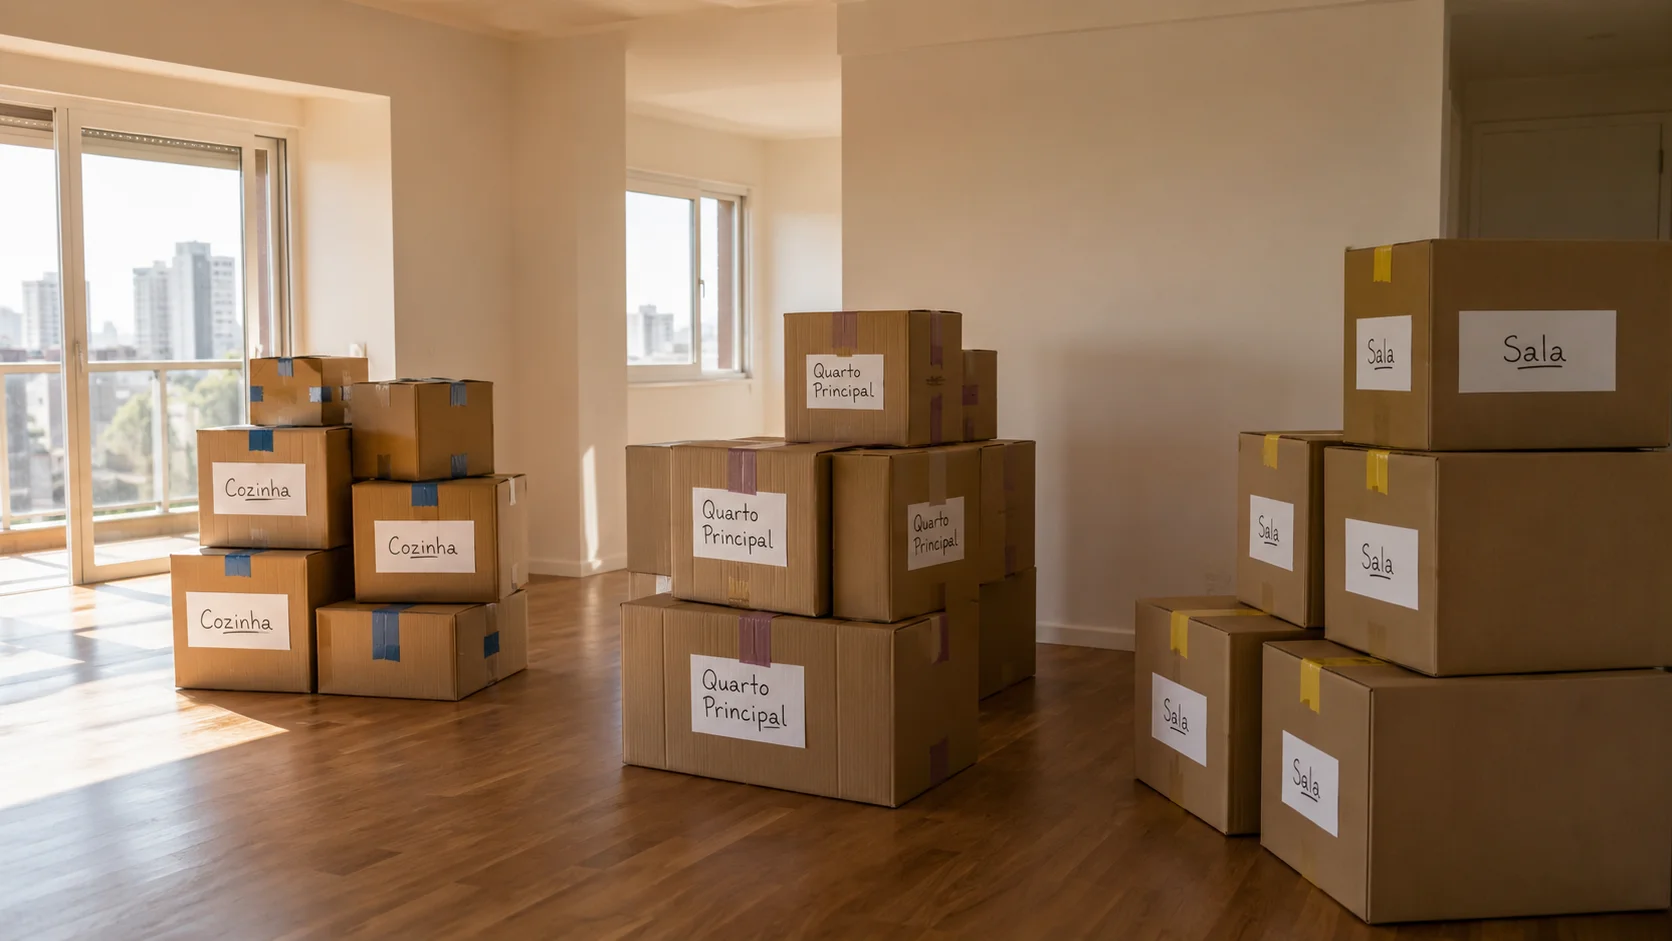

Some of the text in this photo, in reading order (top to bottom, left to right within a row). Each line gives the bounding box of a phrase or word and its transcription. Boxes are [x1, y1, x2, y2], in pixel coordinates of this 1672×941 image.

[1367, 338, 1395, 365] Sala
[1504, 334, 1567, 362] Sala
[813, 362, 861, 380] Quarto
[812, 381, 875, 404] Principal
[225, 477, 292, 498] Cozinha
[702, 498, 759, 522] Quarto
[913, 510, 949, 533] Quarto
[701, 524, 774, 556] Principal
[913, 528, 959, 556] Principal
[1258, 514, 1280, 543] Sala
[388, 535, 459, 556] Cozinha
[1361, 542, 1395, 575] Sala
[200, 608, 274, 631] Cozinha
[701, 668, 770, 697] Quarto
[702, 694, 788, 733] Principal
[1164, 697, 1190, 733] Sala
[1293, 757, 1321, 799] Sala
